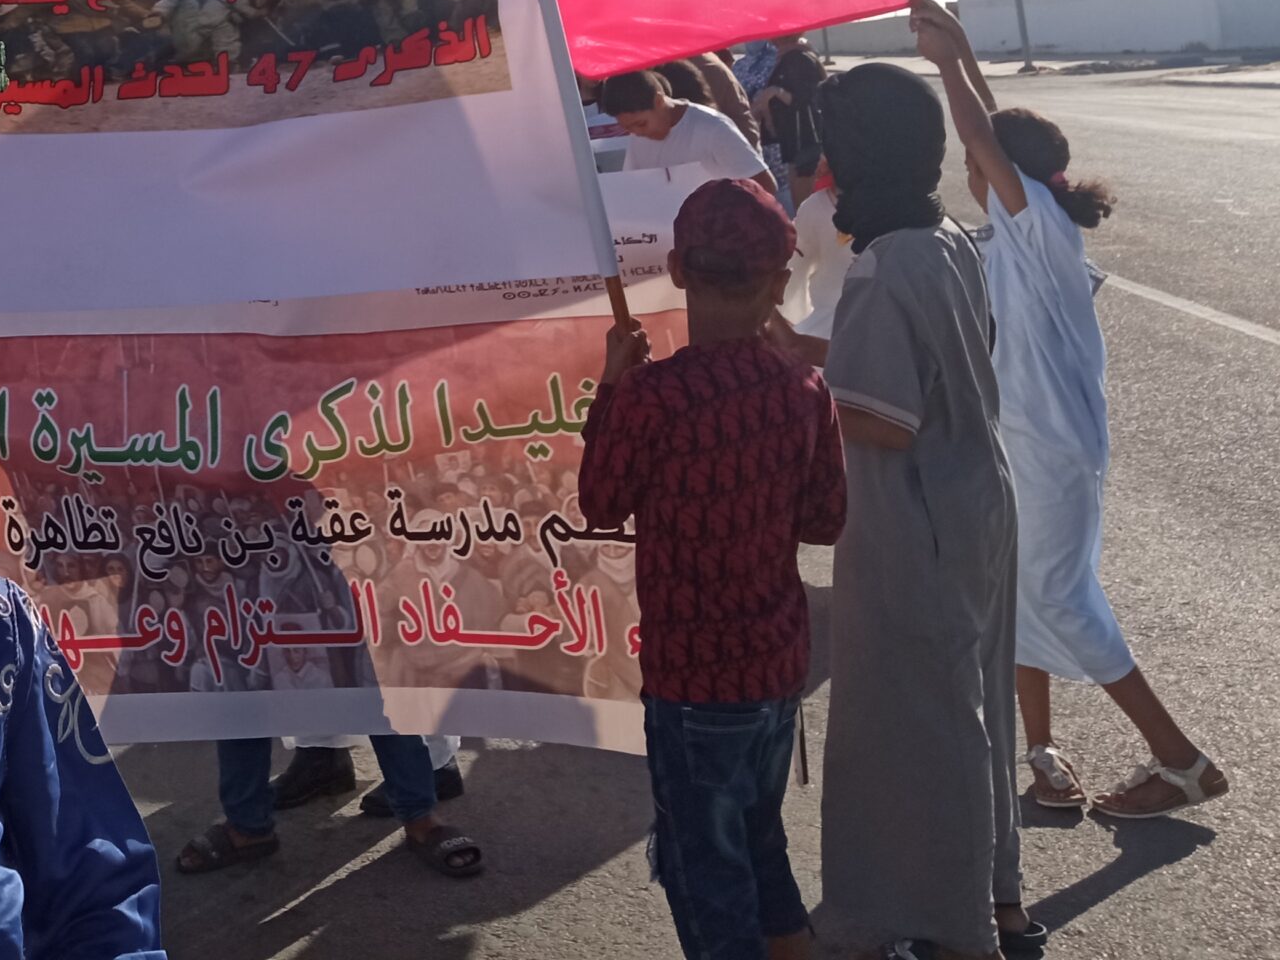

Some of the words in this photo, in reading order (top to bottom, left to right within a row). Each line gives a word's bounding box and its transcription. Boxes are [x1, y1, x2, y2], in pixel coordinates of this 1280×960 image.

[246, 50, 318, 95] 47
[332, 15, 492, 87] الذكرى
[31, 384, 221, 484] المسيرة
[244, 378, 413, 482] لذكرى
[1, 494, 121, 570] تظاهرة
[133, 502, 205, 581] نافع
[219, 514, 277, 568] بن
[286, 496, 372, 564] عقبة
[389, 489, 523, 558] مدرسة
[40, 604, 187, 672] وعه
[203, 580, 381, 684] التزام
[398, 568, 606, 656] الأحفاد
